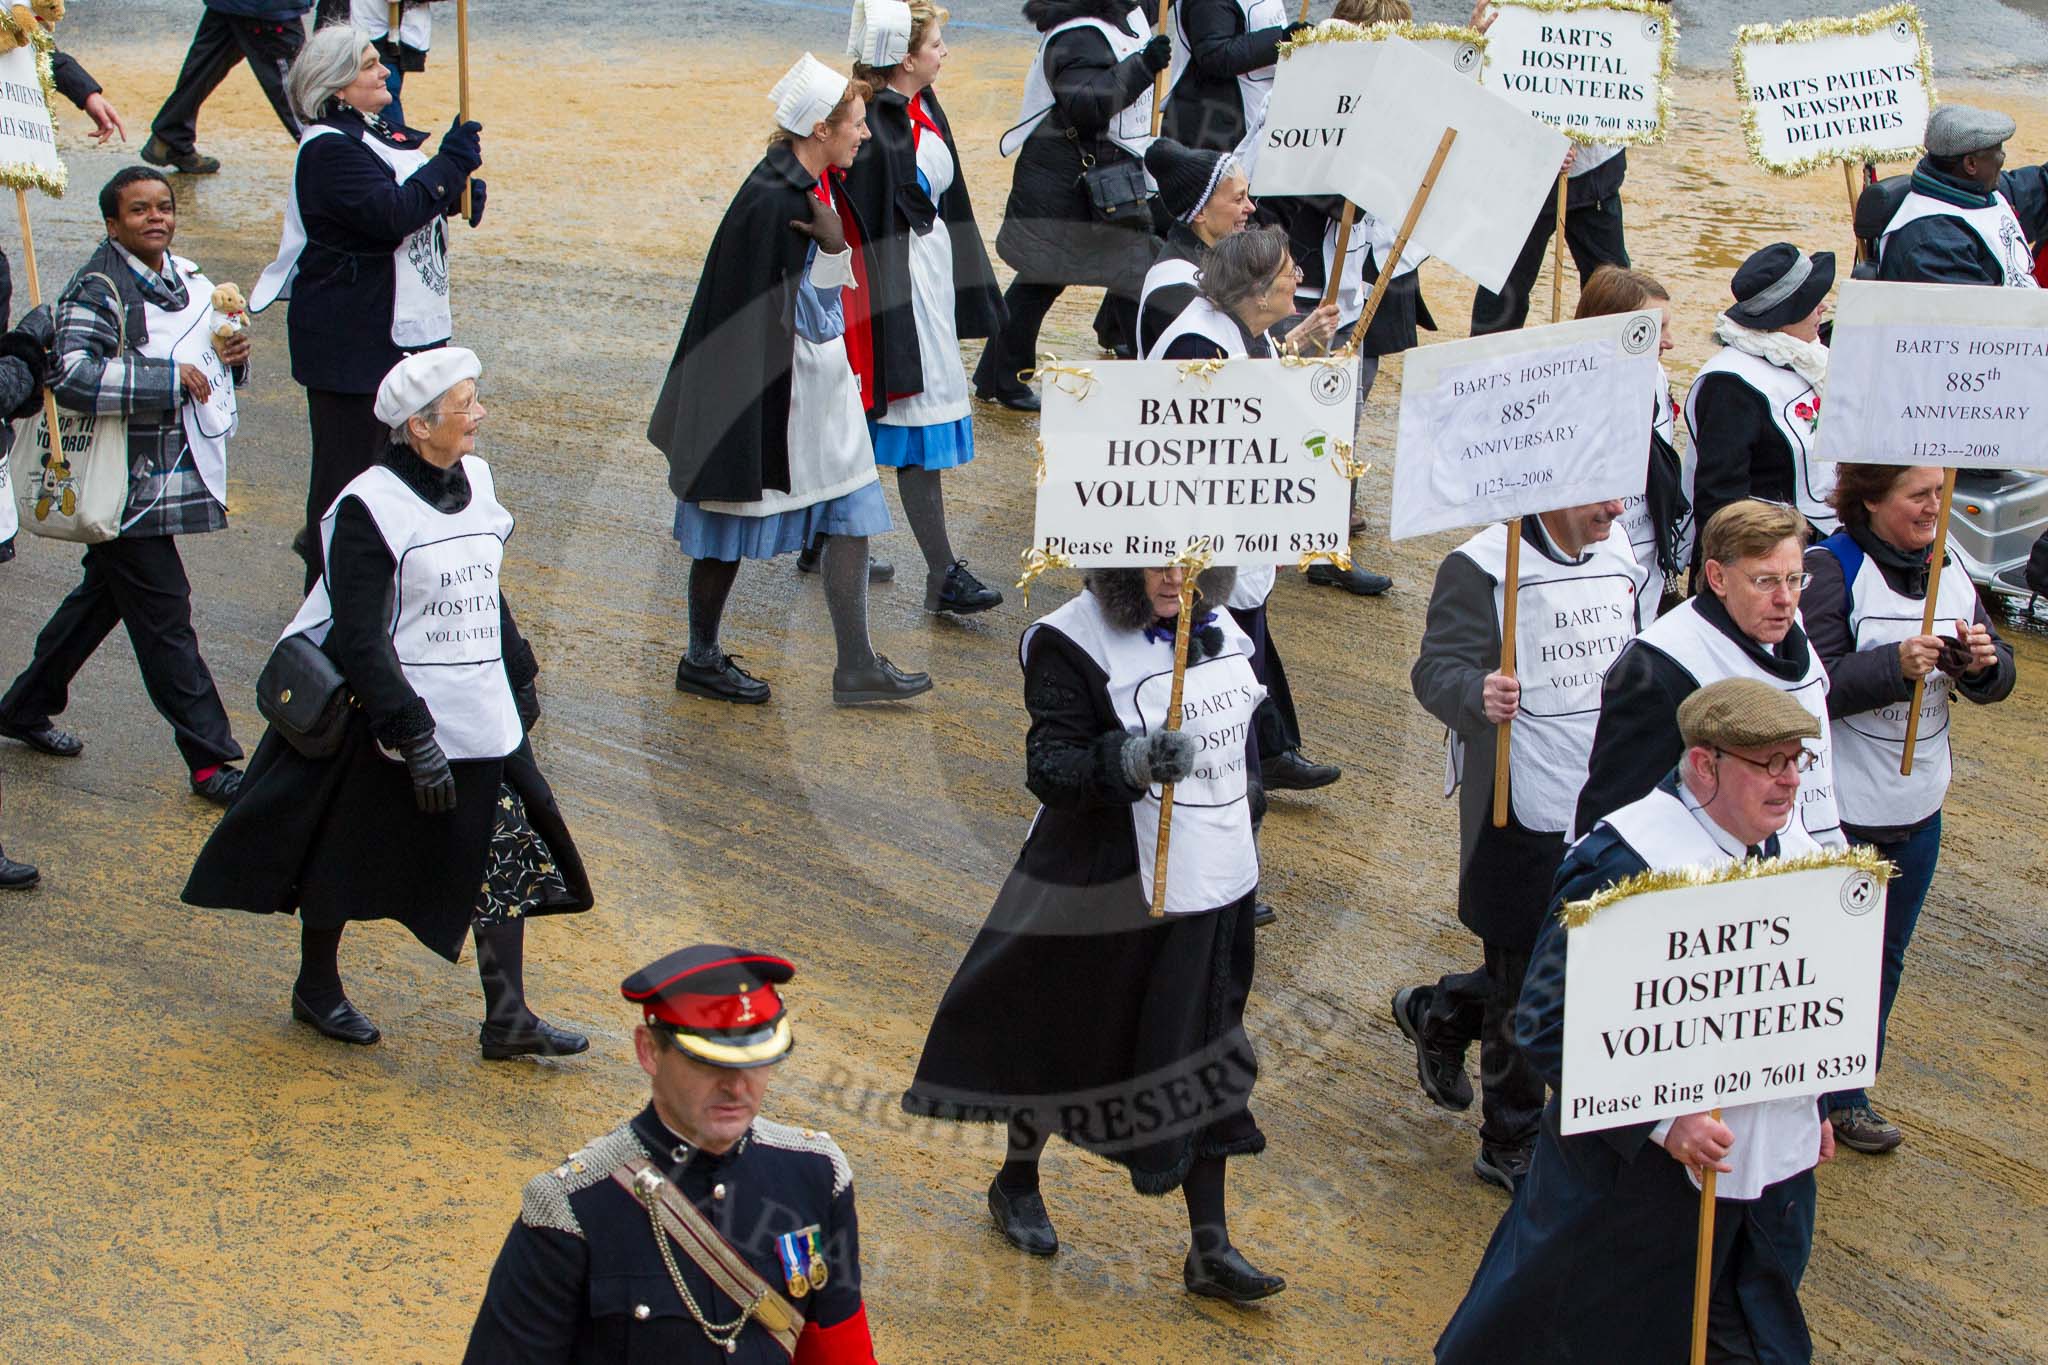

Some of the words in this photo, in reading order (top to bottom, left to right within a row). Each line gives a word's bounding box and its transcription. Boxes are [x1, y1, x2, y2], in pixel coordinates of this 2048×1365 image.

[1541, 26, 1612, 48] BART'S
[1522, 50, 1627, 75] HOSPITAL
[5, 82, 43, 108] PATIENTS
[1502, 73, 1644, 101] VOLUNTEERS
[1753, 78, 1819, 102] BART'S
[1827, 65, 1916, 91] PATIENTS
[1782, 89, 1899, 121] NEWSPAPER
[18, 119, 52, 144] SERVICE
[1567, 114, 1589, 127] 020
[1595, 116, 1621, 129] 7601
[1786, 111, 1904, 144] DELIVERIES
[1896, 339, 1960, 355] BART'S
[1453, 372, 1511, 397] BART'S
[1520, 356, 1599, 384] HOSPITAL
[1946, 367, 2001, 392] 885th
[1138, 397, 1262, 425] BART'S
[1501, 391, 1550, 424] 885th
[1901, 406, 2030, 420] ANNIVERSARY
[1106, 437, 1288, 467] HOSPITAL
[1460, 424, 1578, 461] ANNIVERSARY
[1074, 477, 1316, 507] VOLUNTEERS
[1044, 536, 1113, 556] Please
[1125, 535, 1176, 557] Ring
[1235, 533, 1278, 552] 7601
[1290, 531, 1339, 552] 8339
[1555, 604, 1622, 629] BART'S
[1183, 685, 1251, 721] BART'S
[1666, 916, 1791, 961] BART'S
[1633, 957, 1816, 1011] HOSPITAL
[1600, 997, 1845, 1060] VOLUNTEERS
[1572, 1090, 1642, 1120] Please
[1654, 1081, 1704, 1107] Ring
[1714, 1071, 1751, 1095] 020
[1761, 1063, 1806, 1088] 7601
[1817, 1053, 1867, 1080] 8339
